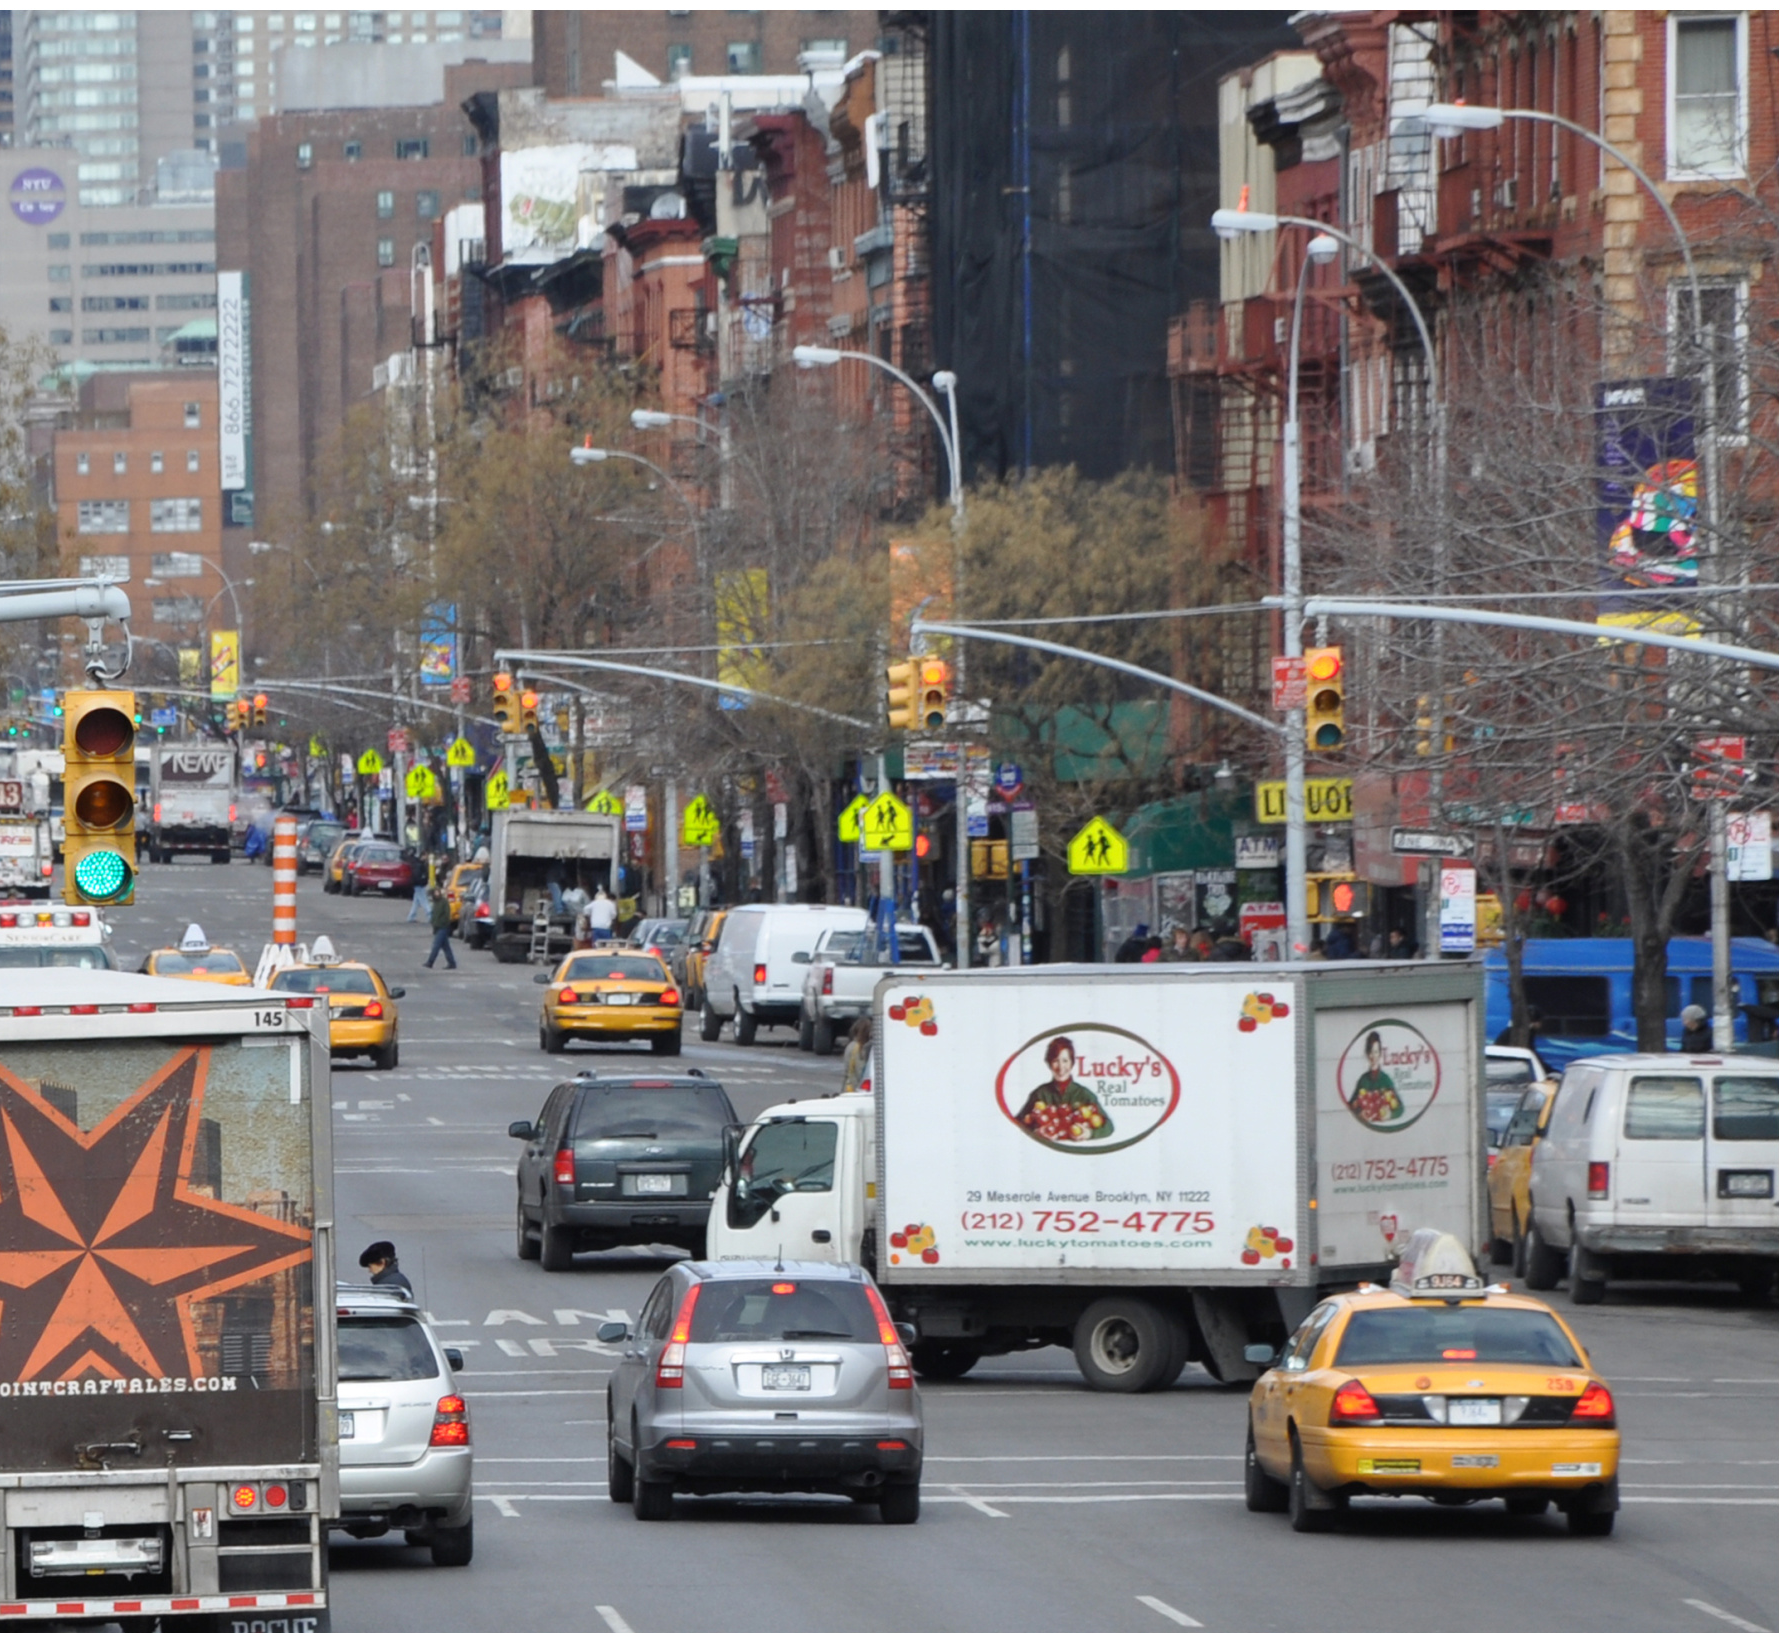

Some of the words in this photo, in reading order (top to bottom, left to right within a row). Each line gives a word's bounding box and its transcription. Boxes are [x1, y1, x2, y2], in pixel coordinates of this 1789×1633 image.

[1264, 786, 1353, 816] LIUO
[253, 1011, 283, 1027] 145
[1076, 1056, 1163, 1084] Lucky's
[1097, 1080, 1127, 1095] Real
[1103, 1093, 1166, 1107] Tomatoes
[1365, 1155, 1449, 1178] 752-4775
[1047, 1191, 1091, 1203] Avenue
[1156, 1191, 1173, 1203] NY
[960, 1211, 1023, 1232] (212)
[1032, 1209, 1216, 1234] 752-4775
[422, 1309, 644, 1327] LAN
[440, 1339, 624, 1357] FIR
